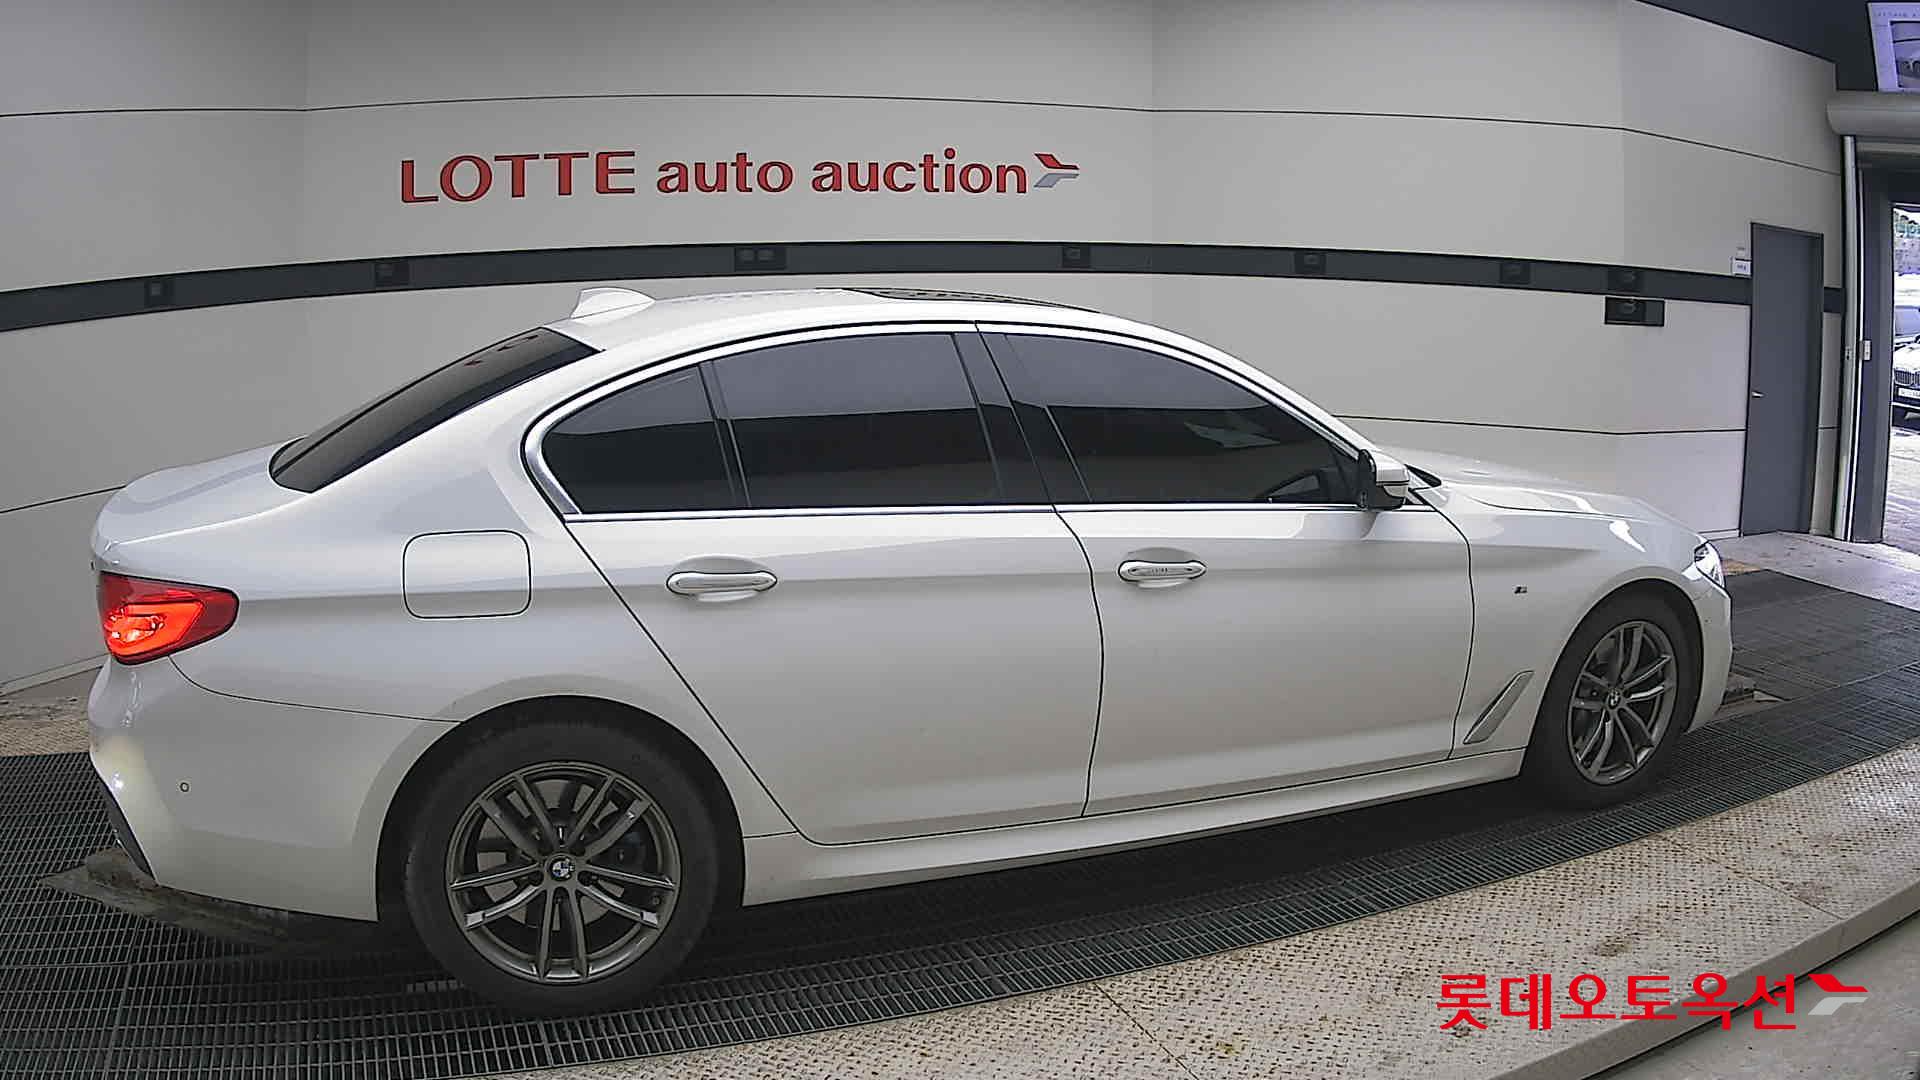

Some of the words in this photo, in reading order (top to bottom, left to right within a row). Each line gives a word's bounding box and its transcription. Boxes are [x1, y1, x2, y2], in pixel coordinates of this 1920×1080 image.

[401, 151, 635, 203] LOTTE
[657, 152, 794, 193] auto
[811, 148, 1028, 193] auction
